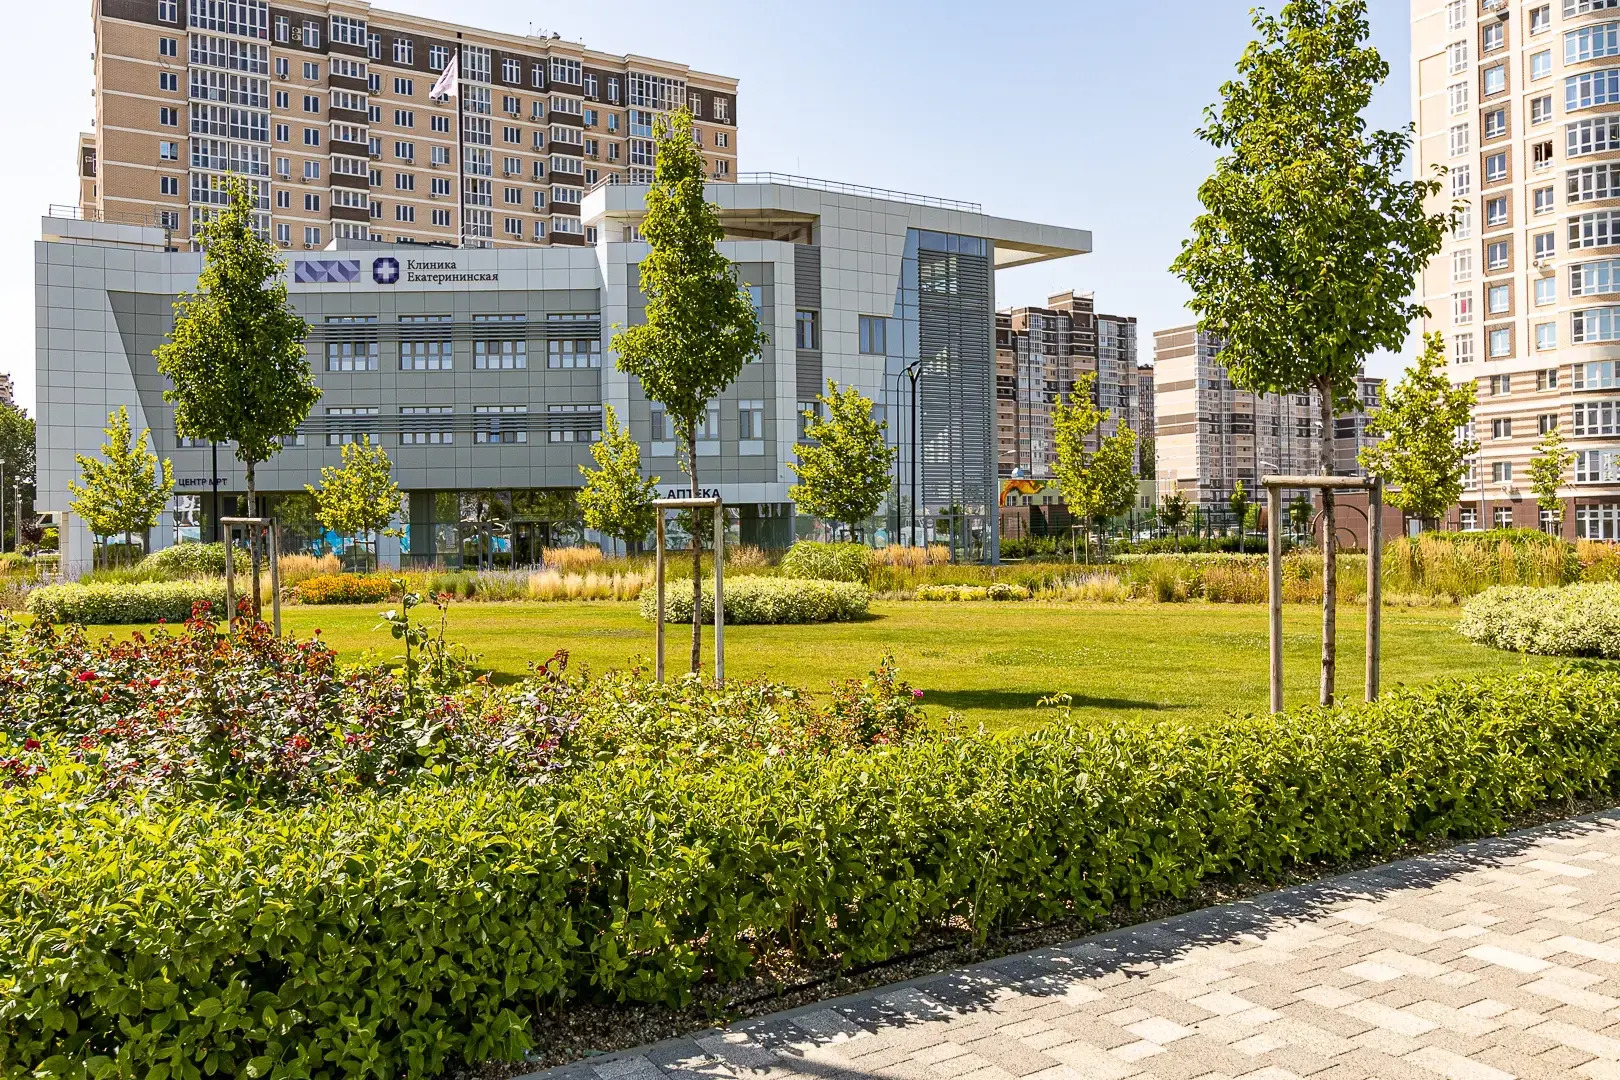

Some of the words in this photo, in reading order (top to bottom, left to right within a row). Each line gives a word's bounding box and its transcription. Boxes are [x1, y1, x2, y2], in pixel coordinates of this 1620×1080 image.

[407, 259, 457, 270] Клиника
[407, 272, 498, 284] Екатерининская
[178, 478, 207, 487] ЦЕНТР
